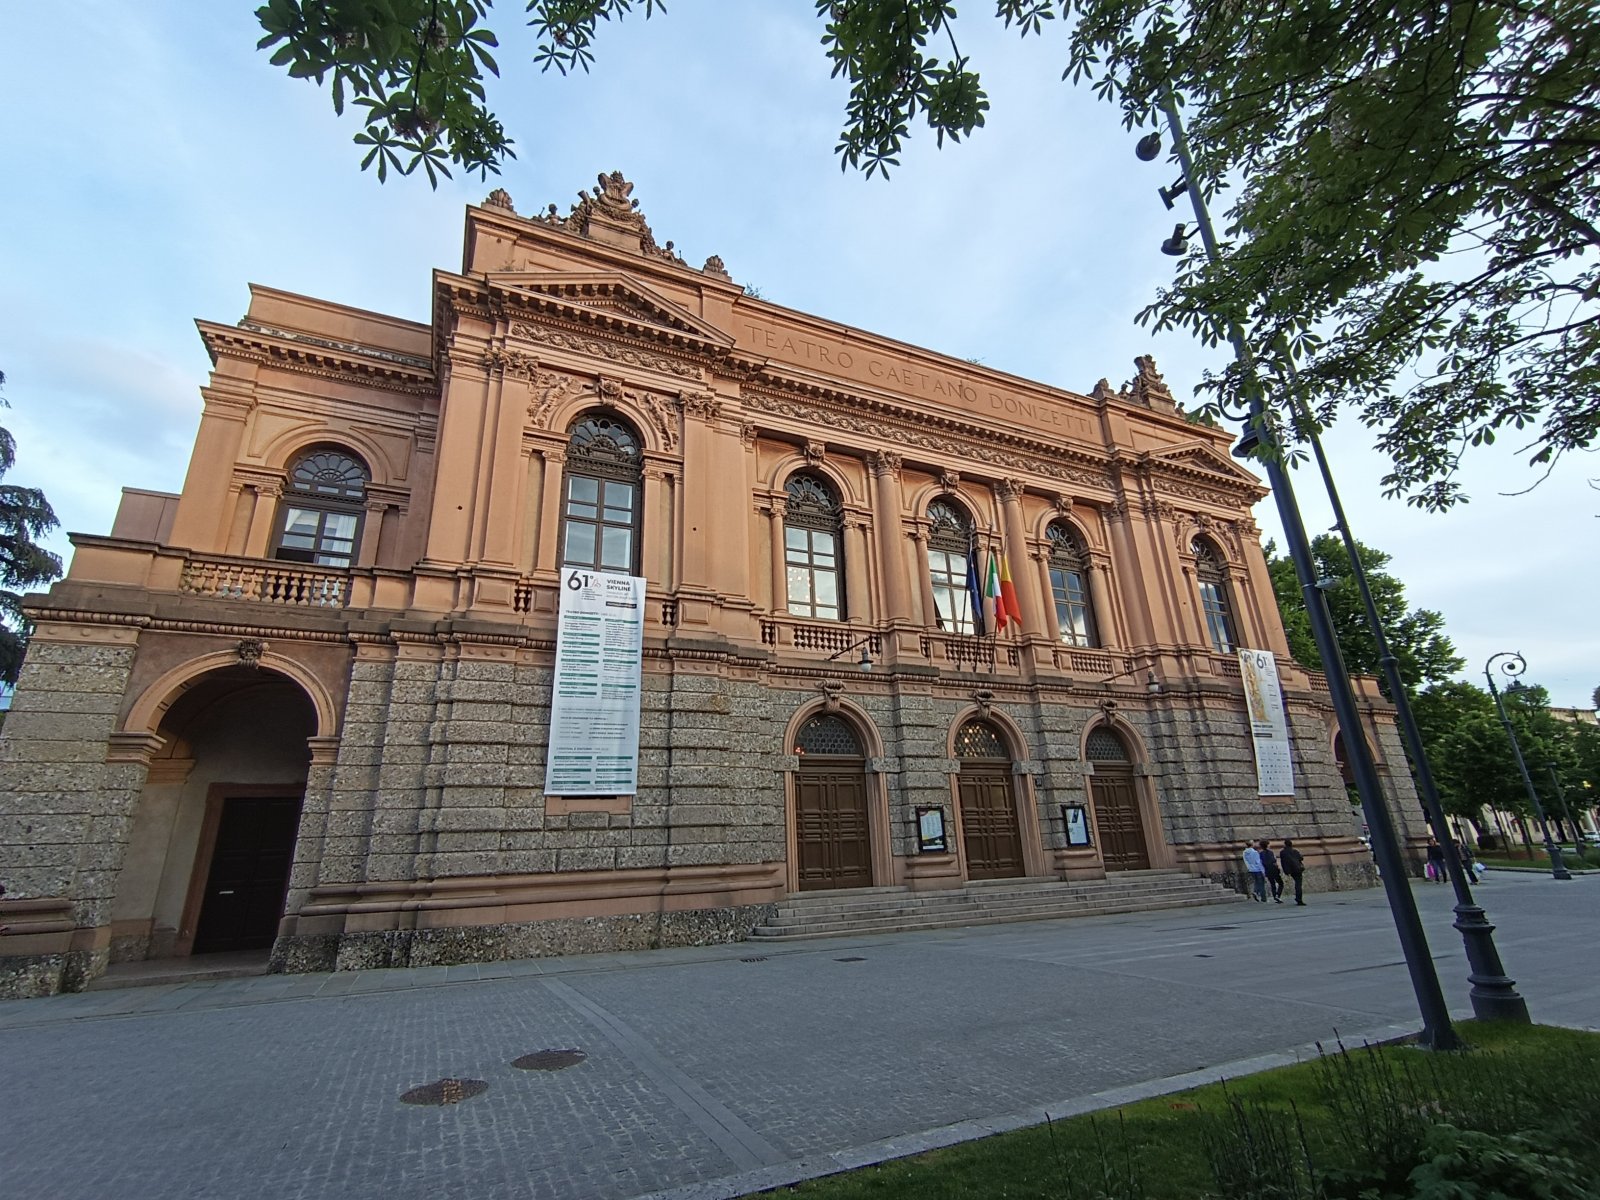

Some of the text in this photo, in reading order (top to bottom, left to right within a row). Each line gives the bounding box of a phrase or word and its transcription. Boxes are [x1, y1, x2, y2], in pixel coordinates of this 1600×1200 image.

[744, 325, 1093, 435] TEATRO GAETANO DONIZETTI
